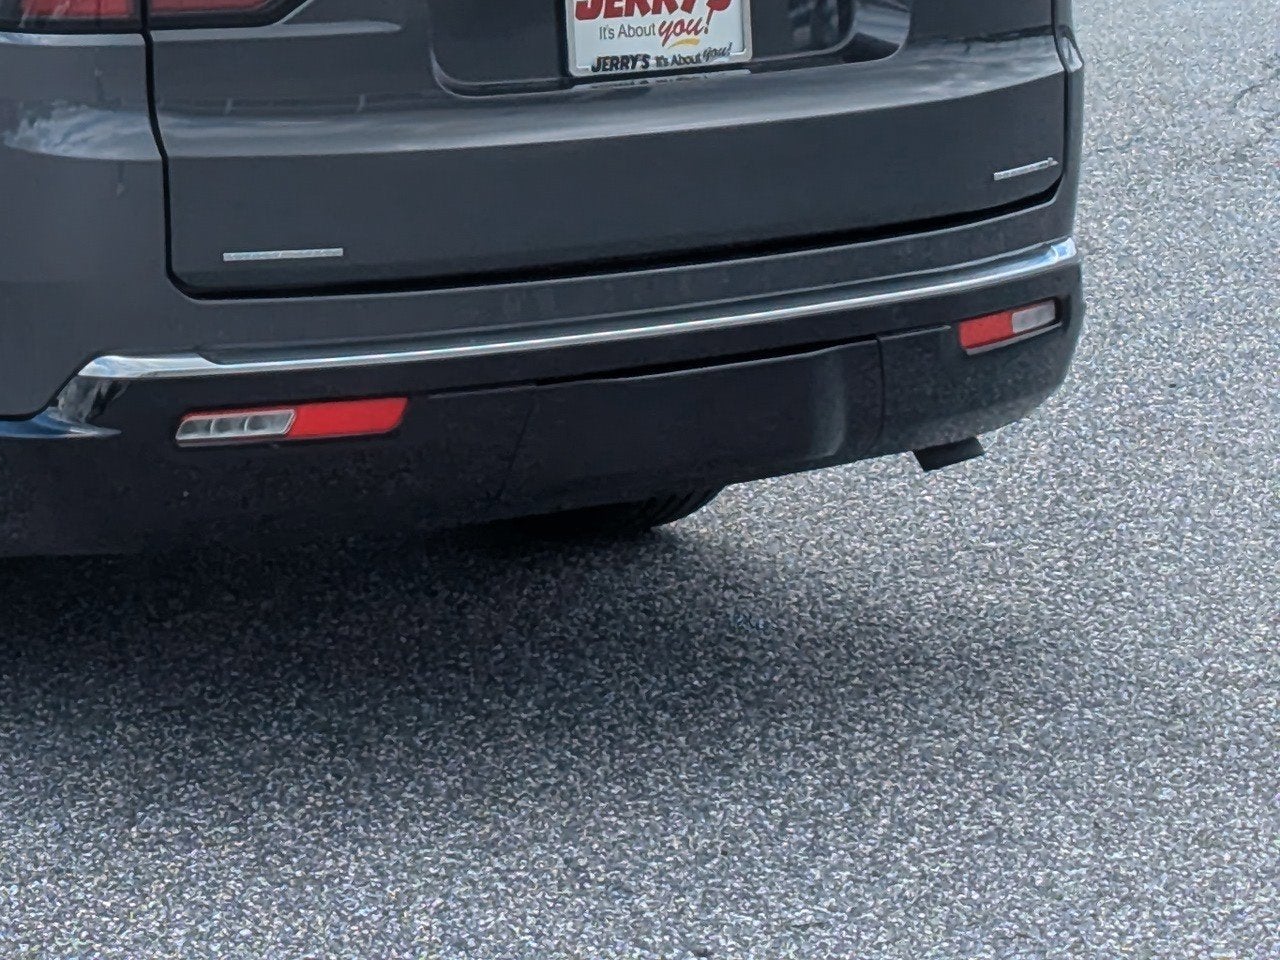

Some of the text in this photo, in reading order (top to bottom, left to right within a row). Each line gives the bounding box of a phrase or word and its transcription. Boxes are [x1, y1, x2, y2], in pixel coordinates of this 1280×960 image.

[599, 7, 714, 47] It's About you!
[591, 53, 651, 73] JERRY'S
[670, 52, 702, 67] About
